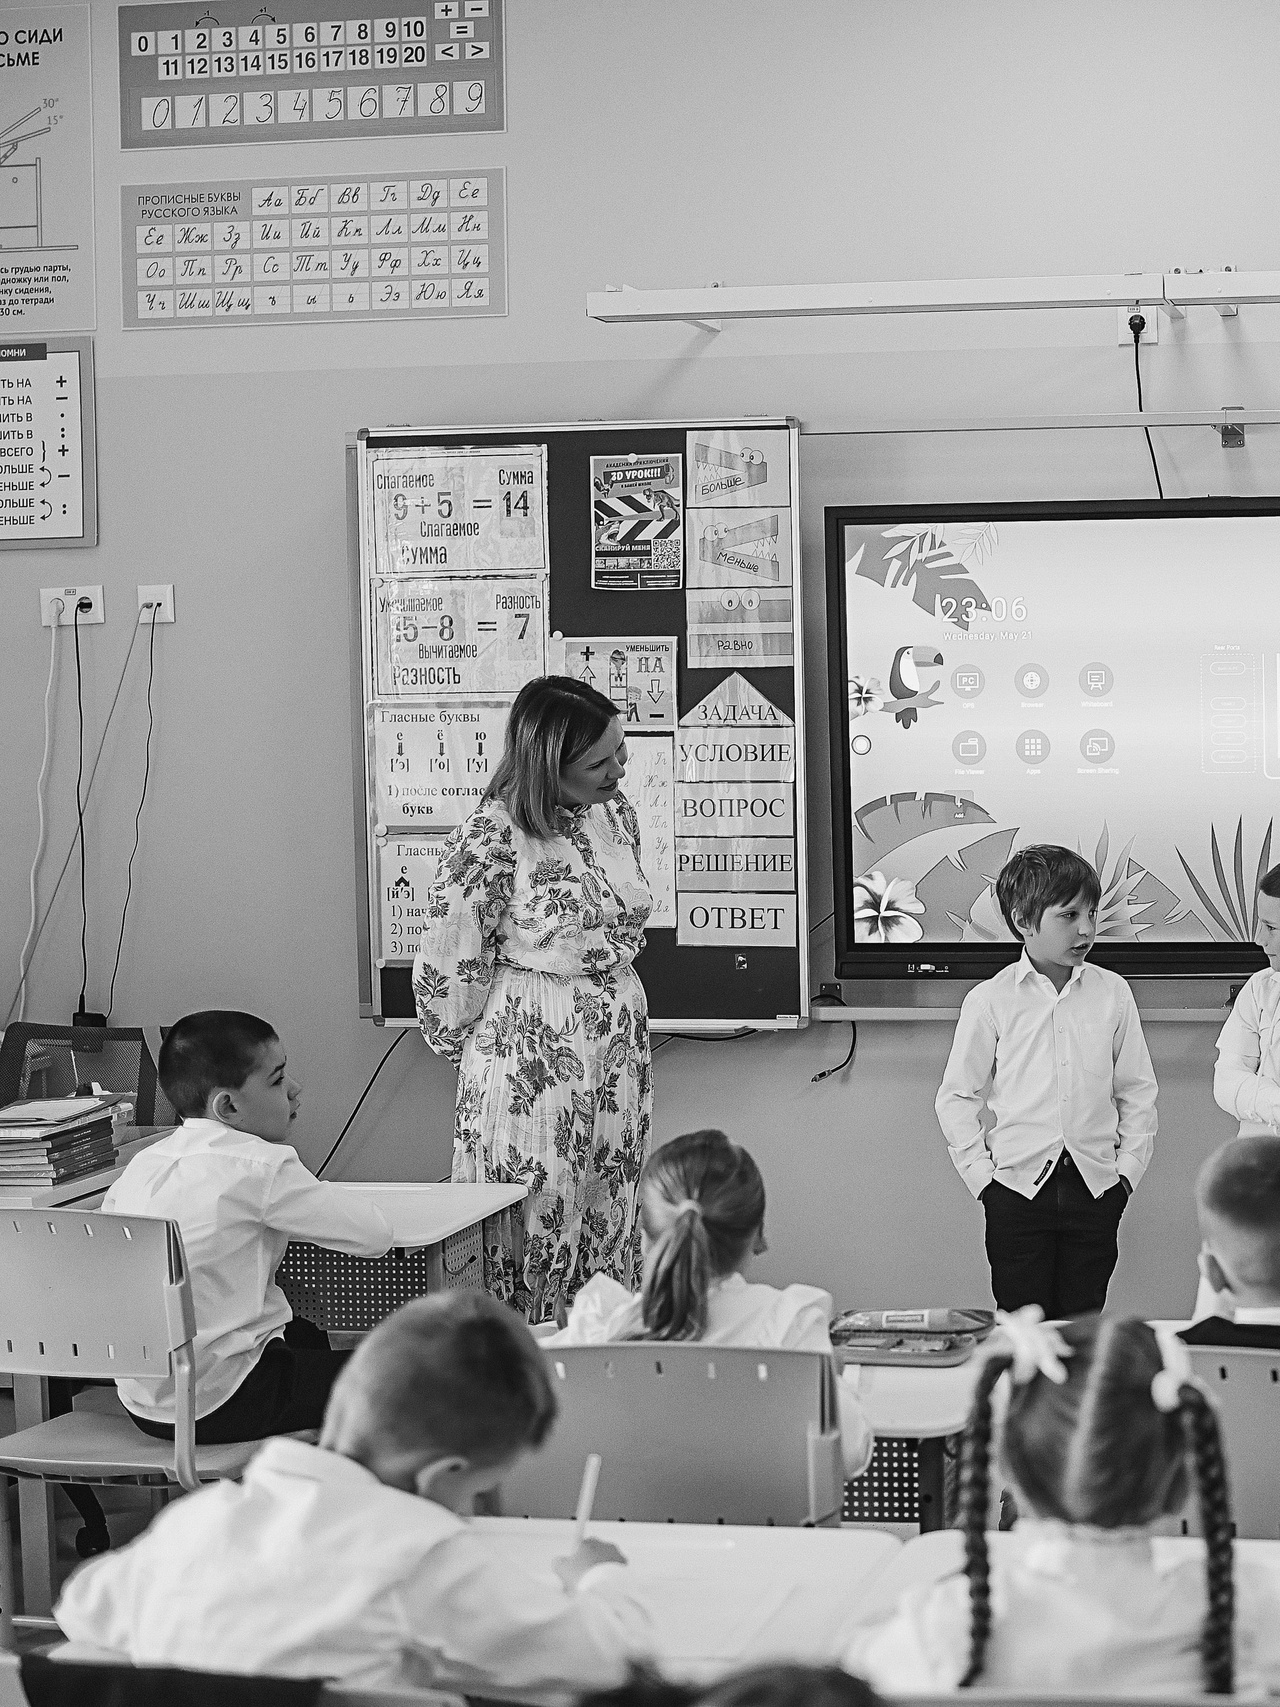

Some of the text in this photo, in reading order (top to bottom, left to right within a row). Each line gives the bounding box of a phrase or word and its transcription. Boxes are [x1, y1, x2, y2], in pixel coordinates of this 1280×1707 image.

[14, 28, 63, 45] СИДИ
[163, 46, 425, 76] 11 12 13 14 15 16 17 18 19 20
[138, 191, 241, 206] ПРОПИСНЫЕ БУКВЫ
[141, 205, 239, 219] РУССКОГО ЯЗЫКА
[11, 264, 71, 275] грудью парты,
[52, 275, 69, 283] пол,
[15, 286, 52, 294] сидения,
[21, 297, 55, 306] тетради
[17, 378, 32, 389] НА
[18, 395, 33, 405] НА
[26, 412, 33, 422] В
[27, 430, 33, 439] В
[0, 446, 34, 457] ВСЕГО
[499, 469, 534, 486] Сумма
[625, 468, 661, 479] УРОК!!!
[393, 490, 530, 520] 9 5 14
[420, 521, 480, 538] Слагаемое
[496, 594, 541, 610] Разность
[941, 597, 1028, 623] 23:06
[439, 614, 454, 642] 8
[515, 613, 530, 640] 7
[943, 631, 1033, 642] Wednesday, May 21
[419, 643, 478, 660] Вычитаемое
[626, 644, 670, 652] УМЕНЬШИТЬ
[637, 657, 665, 673] НА
[962, 677, 974, 685] PC
[381, 711, 480, 726] Гласные буквы
[697, 704, 779, 724] ЗАДАЧА
[679, 743, 792, 763] УСЛОВИЕ
[402, 786, 438, 797] после
[402, 803, 434, 816] букв
[682, 798, 786, 819] ВОПРОС
[678, 854, 793, 873] РЕШЕНИЕ
[689, 907, 785, 931] ОТВЕТ
